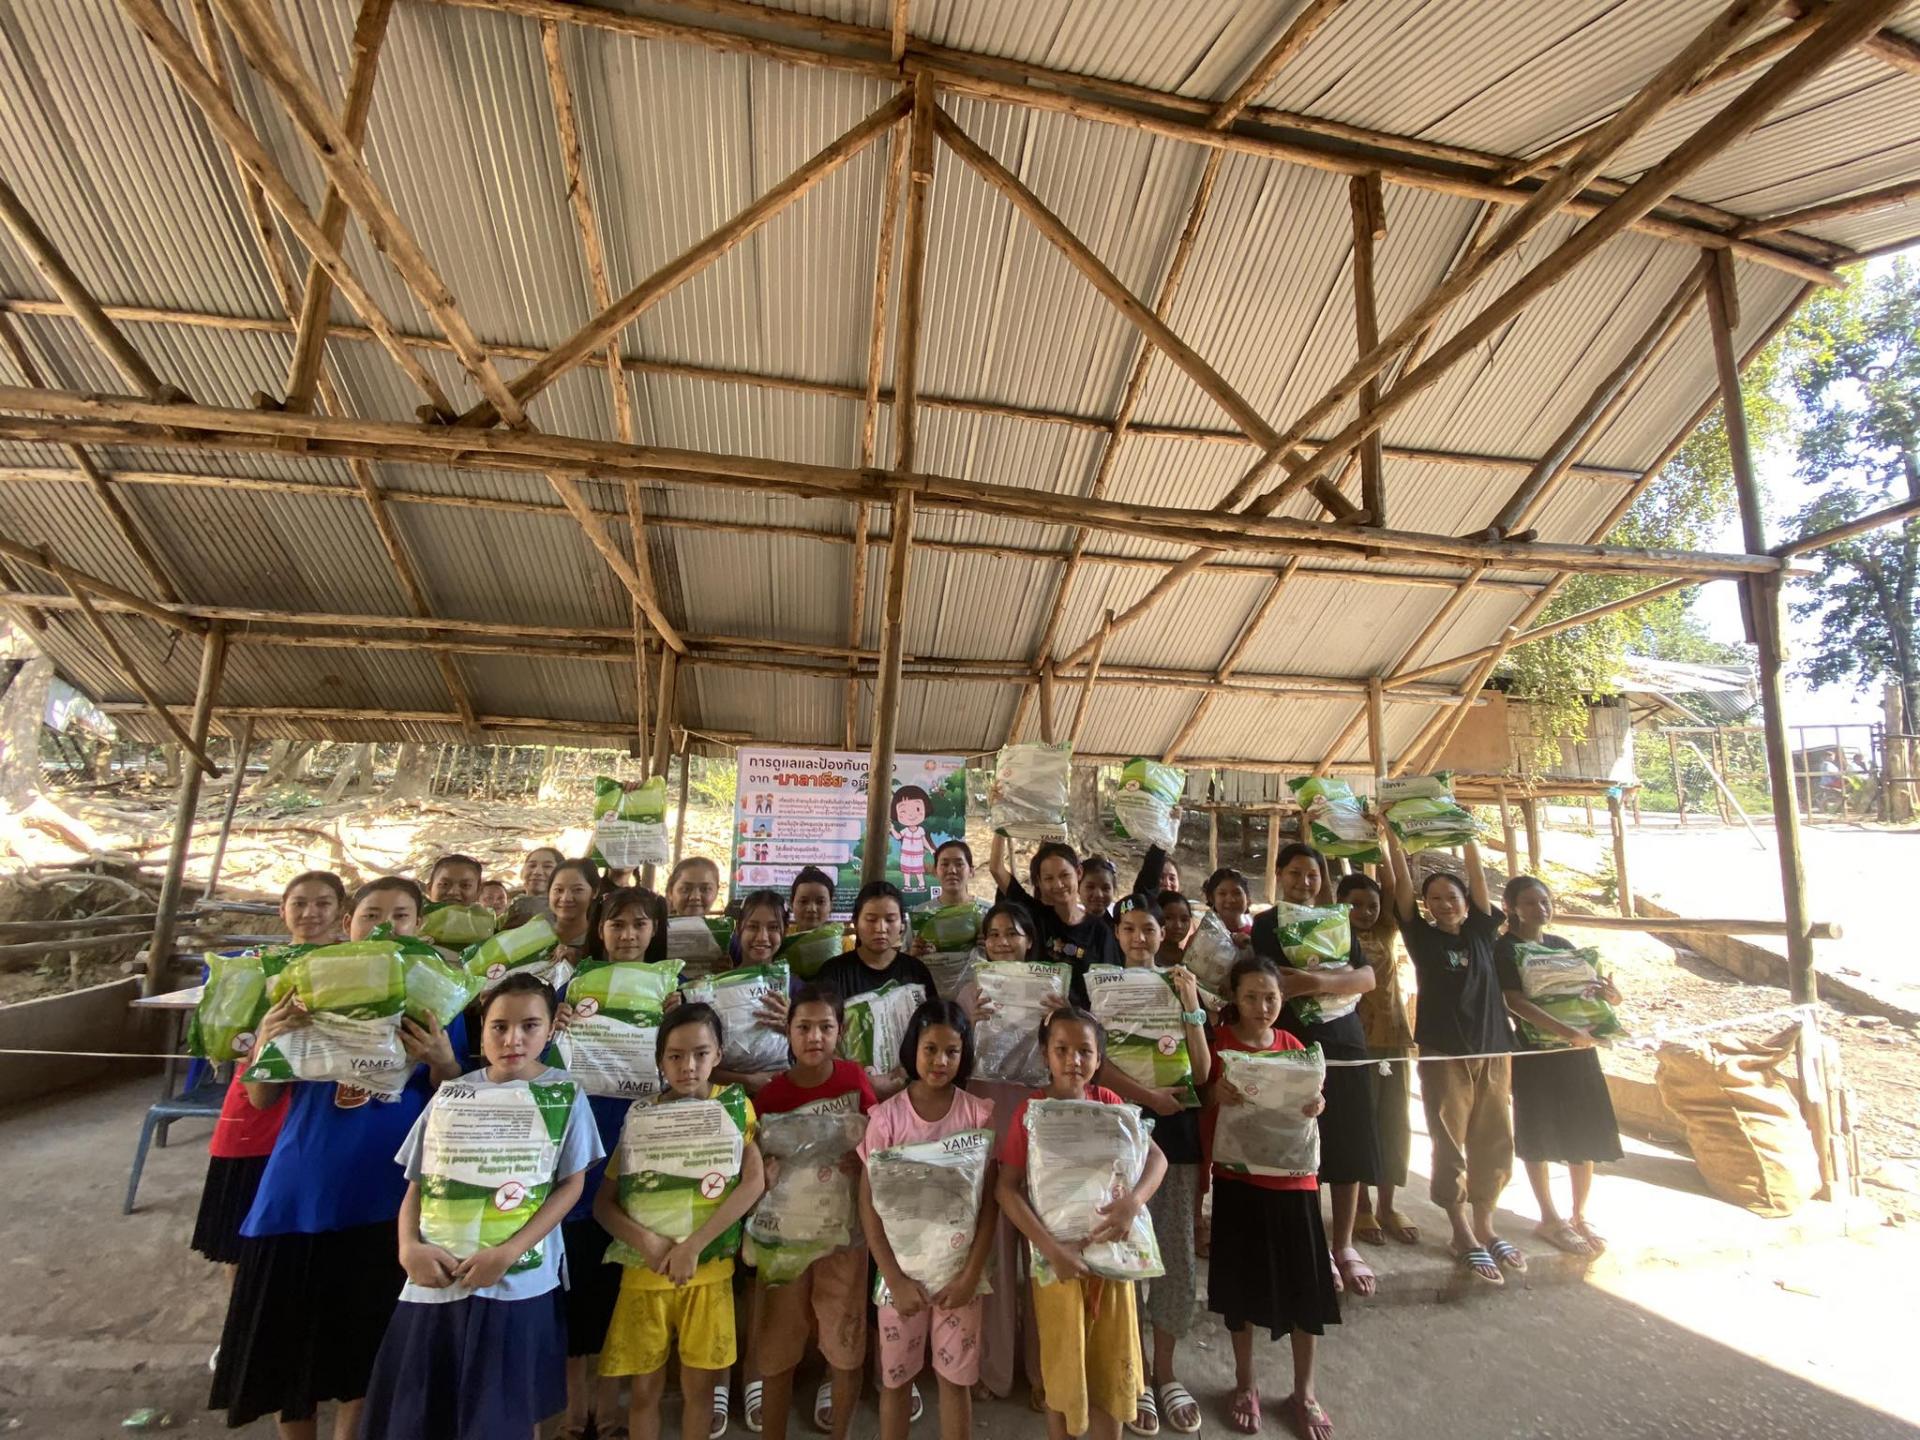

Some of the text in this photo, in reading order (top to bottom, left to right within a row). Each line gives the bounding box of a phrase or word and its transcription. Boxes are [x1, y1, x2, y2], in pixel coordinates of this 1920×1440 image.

[749, 774, 769, 783] จาก
[1028, 964, 1061, 974] YAMEI
[1094, 973, 1124, 984] YAMEI
[350, 1059, 394, 1069] YAME
[617, 1080, 653, 1092] YAMEI
[812, 1095, 852, 1116] YAMEI
[942, 1133, 983, 1151] YAMEI
[451, 1156, 488, 1165] Treated
[478, 1165, 537, 1175] Long Lasting
